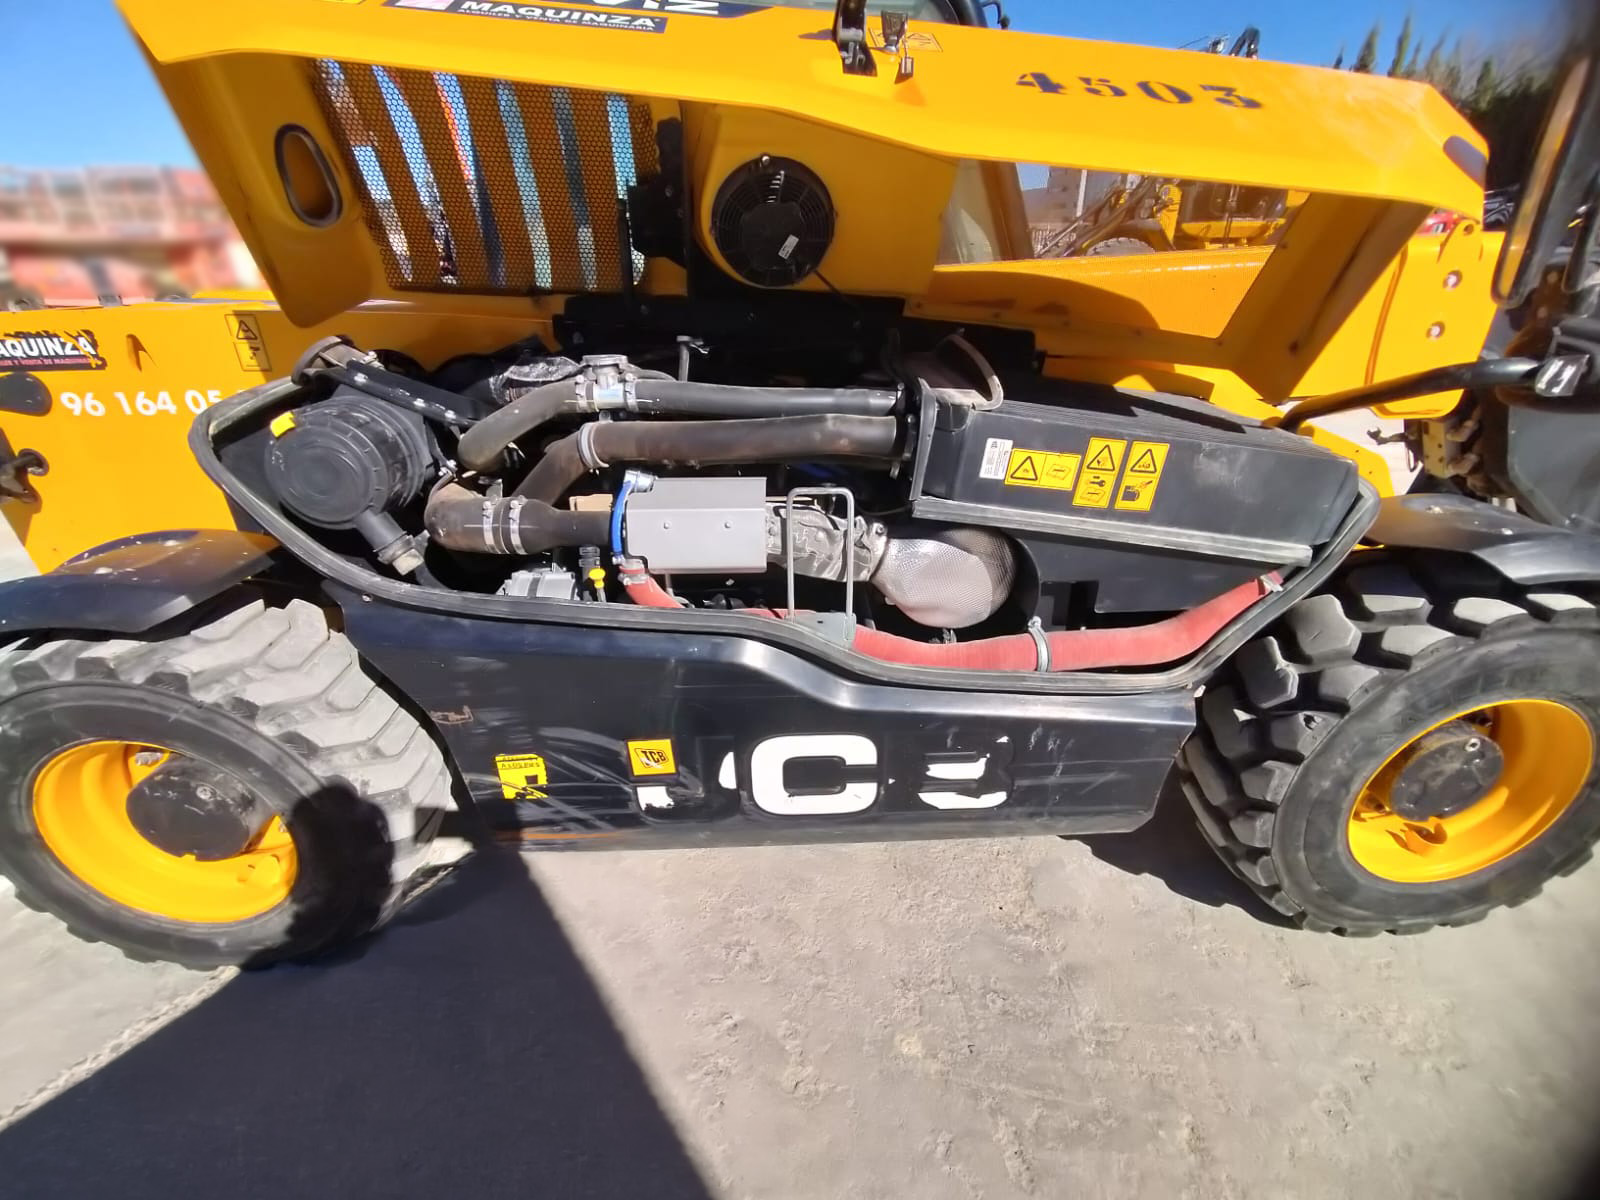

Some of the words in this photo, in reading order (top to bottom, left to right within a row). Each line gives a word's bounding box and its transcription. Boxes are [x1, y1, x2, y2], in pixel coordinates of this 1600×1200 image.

[460, 0, 656, 27] MAQUINZA
[1016, 72, 1264, 109] 4503
[60, 391, 106, 417] 96
[114, 391, 177, 416] 164
[641, 750, 668, 766] JCB
